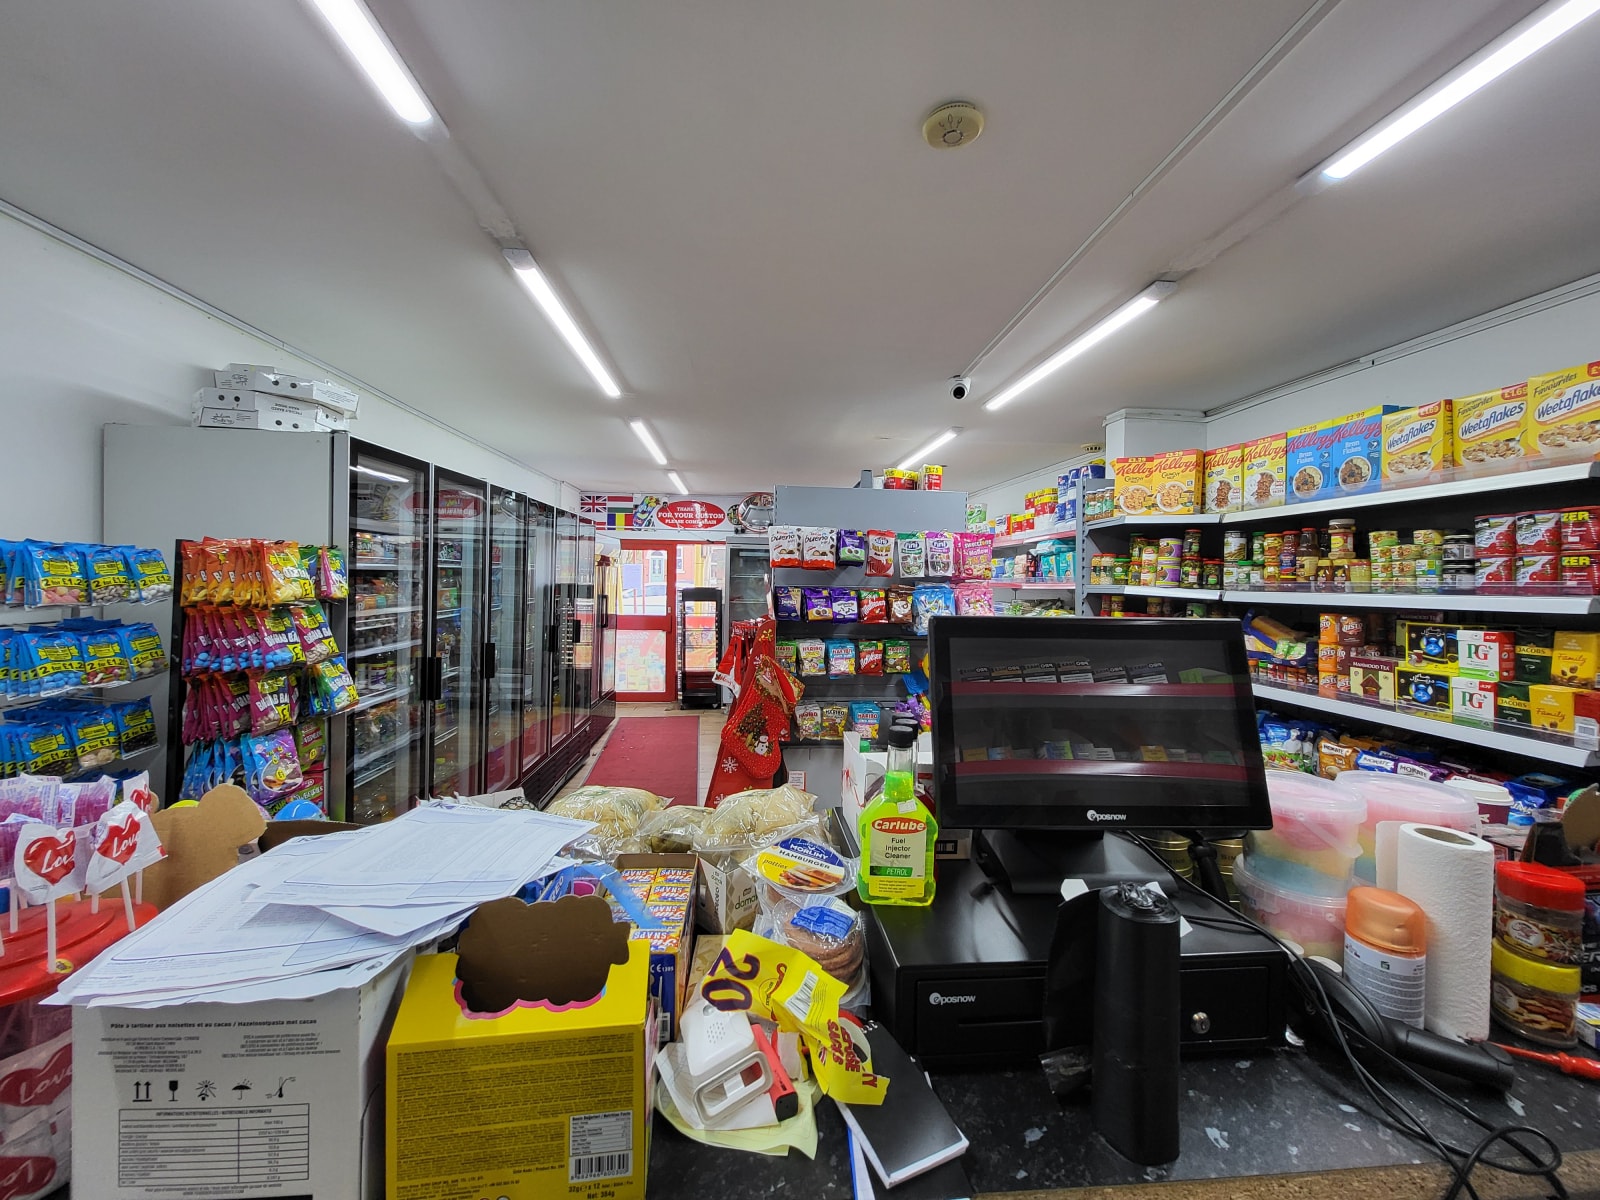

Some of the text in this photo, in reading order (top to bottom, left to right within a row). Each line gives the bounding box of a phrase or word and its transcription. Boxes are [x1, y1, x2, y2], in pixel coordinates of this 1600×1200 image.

[1538, 384, 1600, 419] Weetaflake
[1461, 402, 1524, 437] Weetaflakes
[1387, 420, 1436, 450] Weetaflakes
[1561, 512, 1589, 522] ZER
[771, 533, 795, 542] bueno
[805, 535, 828, 543] bueno
[1562, 556, 1590, 565] ZER
[44, 578, 50, 586] 2
[62, 577, 83, 586] £1.2
[113, 576, 128, 584] £1.2
[288, 632, 300, 642] BA
[1468, 643, 1489, 660] PG
[1352, 661, 1377, 669] MAHMOOD
[1558, 653, 1587, 666] Family
[40, 666, 48, 674] 2
[279, 692, 290, 703] BA
[1461, 691, 1484, 709] PG
[1500, 699, 1527, 708] JACOBS
[1536, 707, 1566, 720] Family
[100, 738, 118, 746] £1.2
[30, 761, 38, 769] 2
[51, 752, 69, 760] £1.2
[1399, 763, 1427, 777] MOKATE
[874, 820, 925, 831] Carlube
[790, 844, 829, 859] MORLINY
[779, 850, 830, 870] HAMBURGER
[632, 930, 667, 939] SNAPS
[701, 947, 760, 1011] 20
[929, 992, 976, 1005] eposnow
